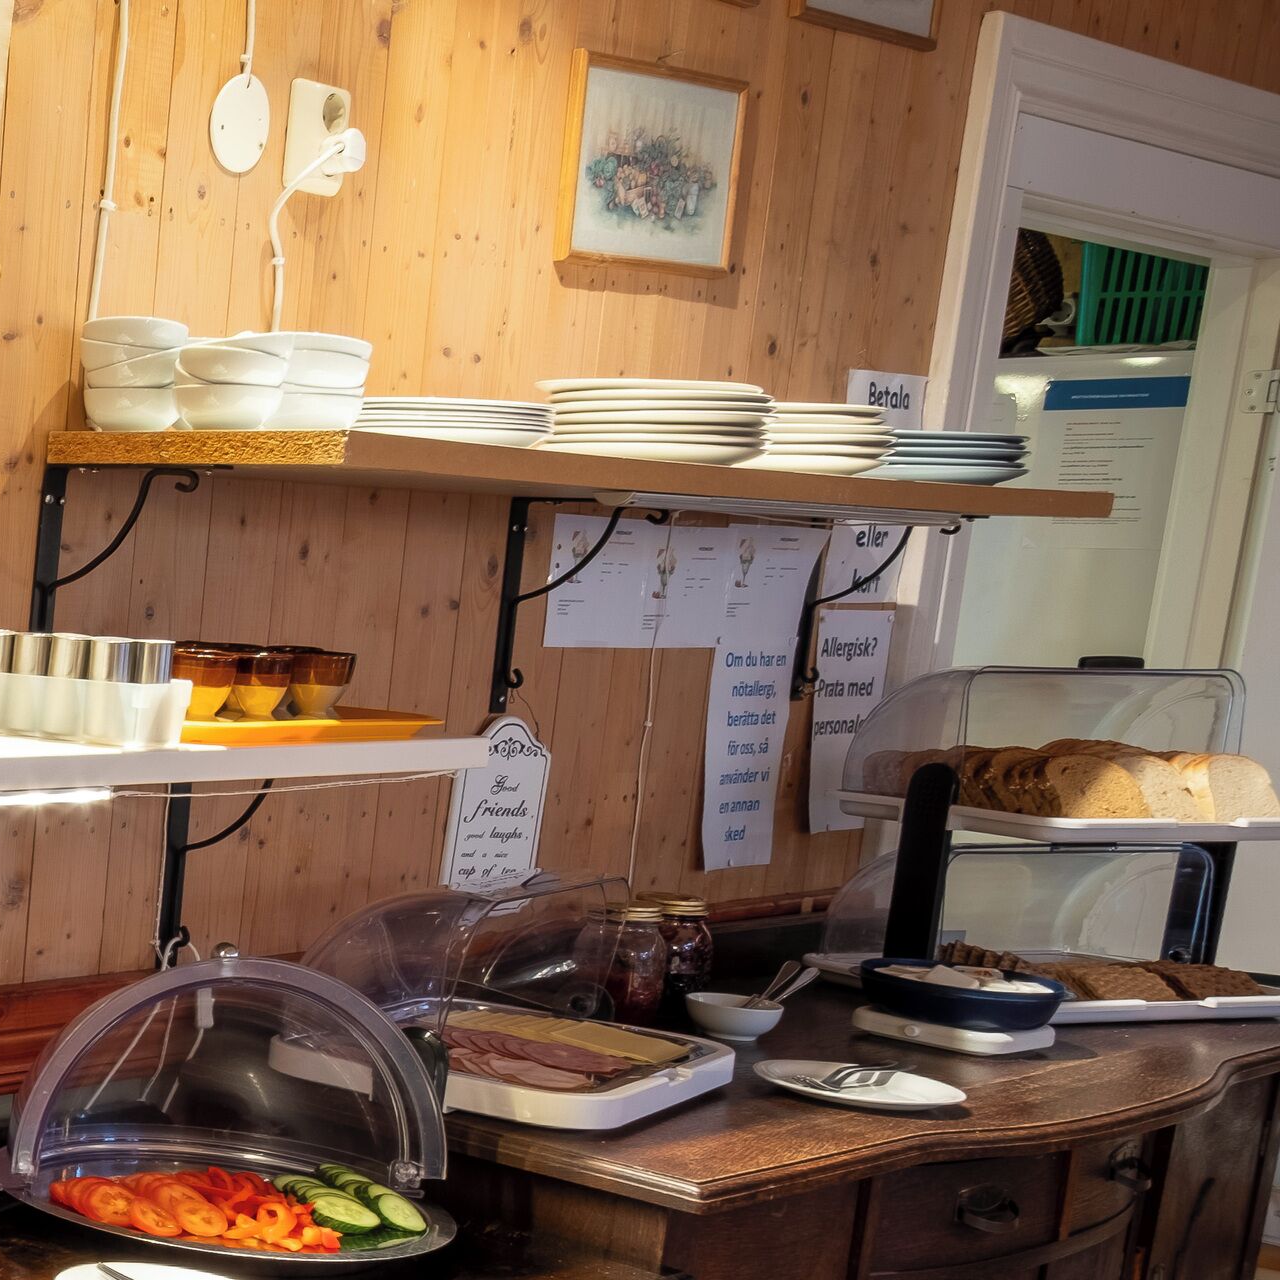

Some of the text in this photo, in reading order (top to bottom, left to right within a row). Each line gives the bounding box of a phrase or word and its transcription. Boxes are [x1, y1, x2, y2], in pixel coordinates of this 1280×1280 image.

[867, 381, 911, 411] Betala
[855, 525, 889, 549] eller
[820, 636, 879, 662] Allergisk?
[725, 650, 787, 668] Om du har en
[731, 679, 777, 698] nötallergi,
[817, 676, 875, 698] Prata med
[727, 710, 776, 728] berätta det
[727, 740, 739, 756] för
[758, 736, 769, 754] så
[490, 774, 520, 796] Good
[719, 766, 771, 786] använder vi
[718, 799, 760, 815] en annan
[463, 830, 486, 842] good
[723, 824, 746, 842] sked
[460, 850, 476, 858] and
[458, 866, 476, 880] cup
[482, 863, 497, 879] of
